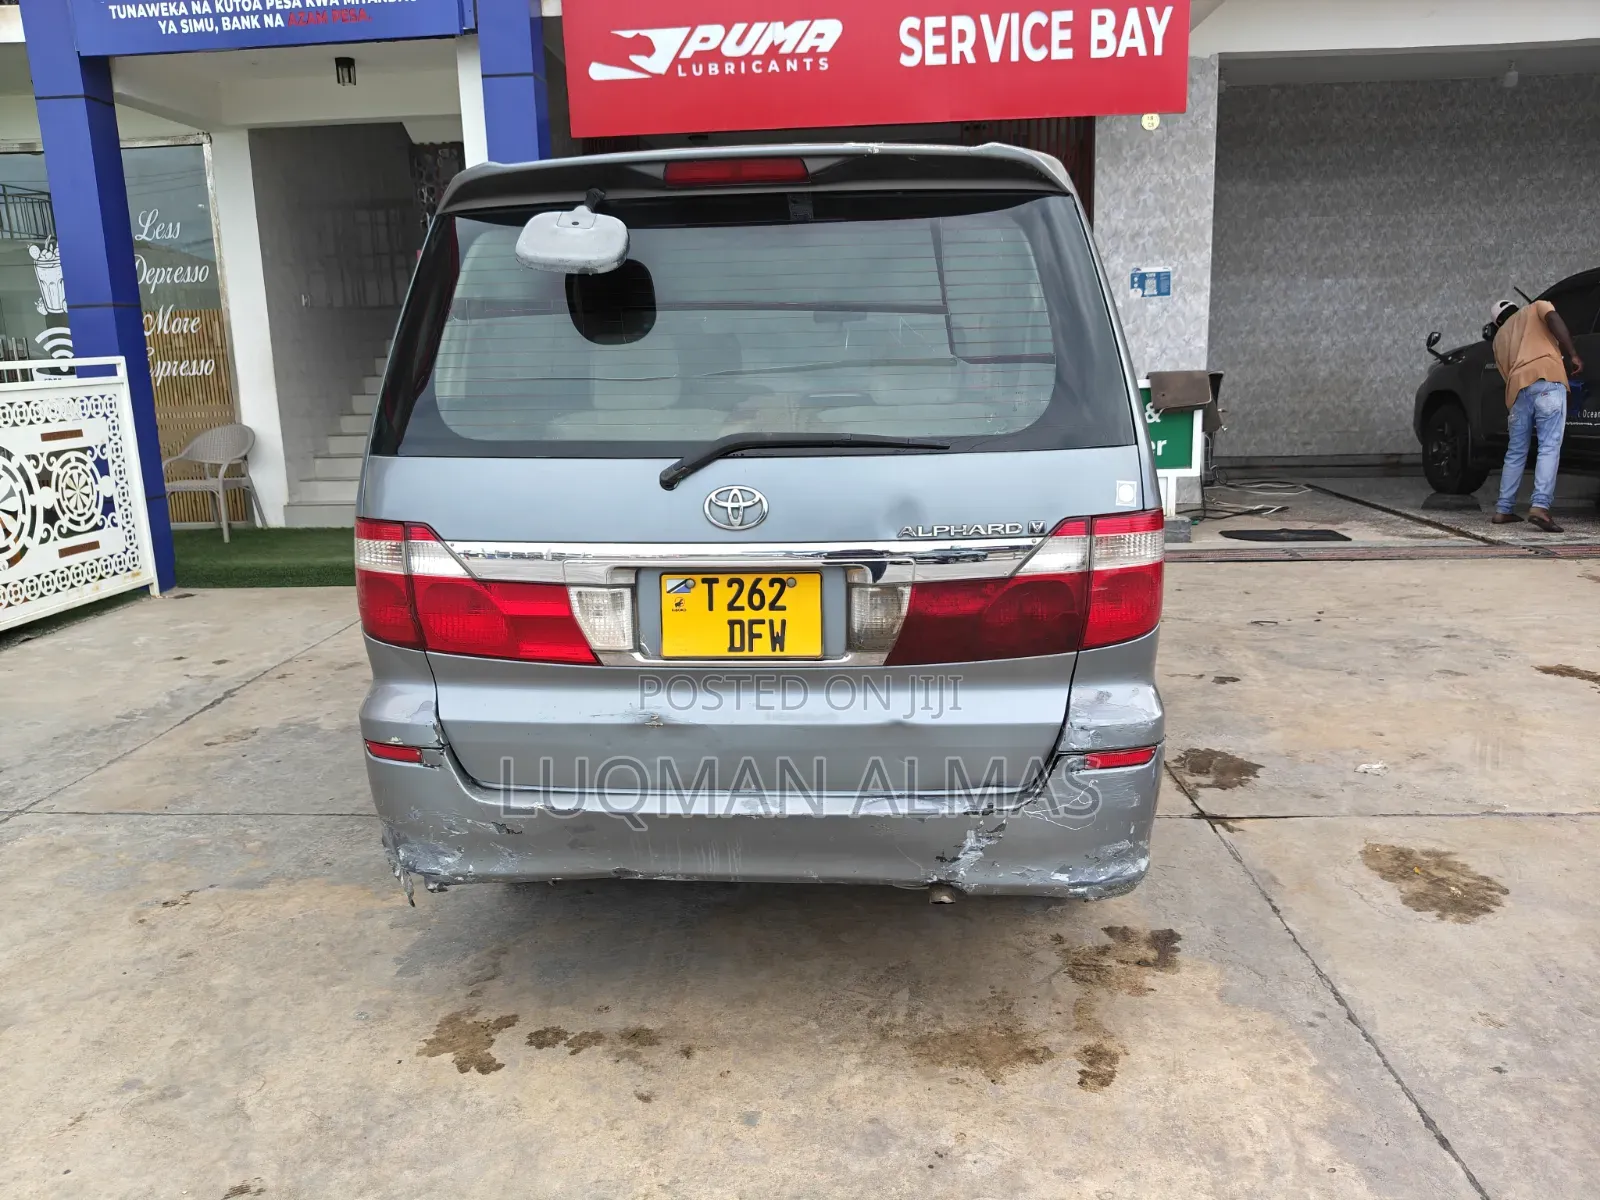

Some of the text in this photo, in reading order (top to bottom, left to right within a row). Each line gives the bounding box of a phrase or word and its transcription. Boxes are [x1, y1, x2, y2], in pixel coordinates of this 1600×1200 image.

[109, 1, 189, 19] TUNAWEKA
[192, 0, 212, 15] NA
[215, 0, 262, 13] KUTOA
[266, 0, 302, 10] PESA
[158, 7, 373, 35] YA SIMU, BANK NA AZAM PESA.
[679, 18, 843, 59] PUMA
[899, 6, 1174, 68] SERVICE BAY
[677, 57, 830, 77] LUBRICANTS
[134, 208, 181, 241] Less
[134, 254, 210, 294] Depresso
[142, 303, 203, 337] More
[1145, 402, 1164, 423] &
[897, 522, 1023, 538] ALPHARD
[701, 577, 787, 612] T 262
[726, 618, 787, 652] DFW
